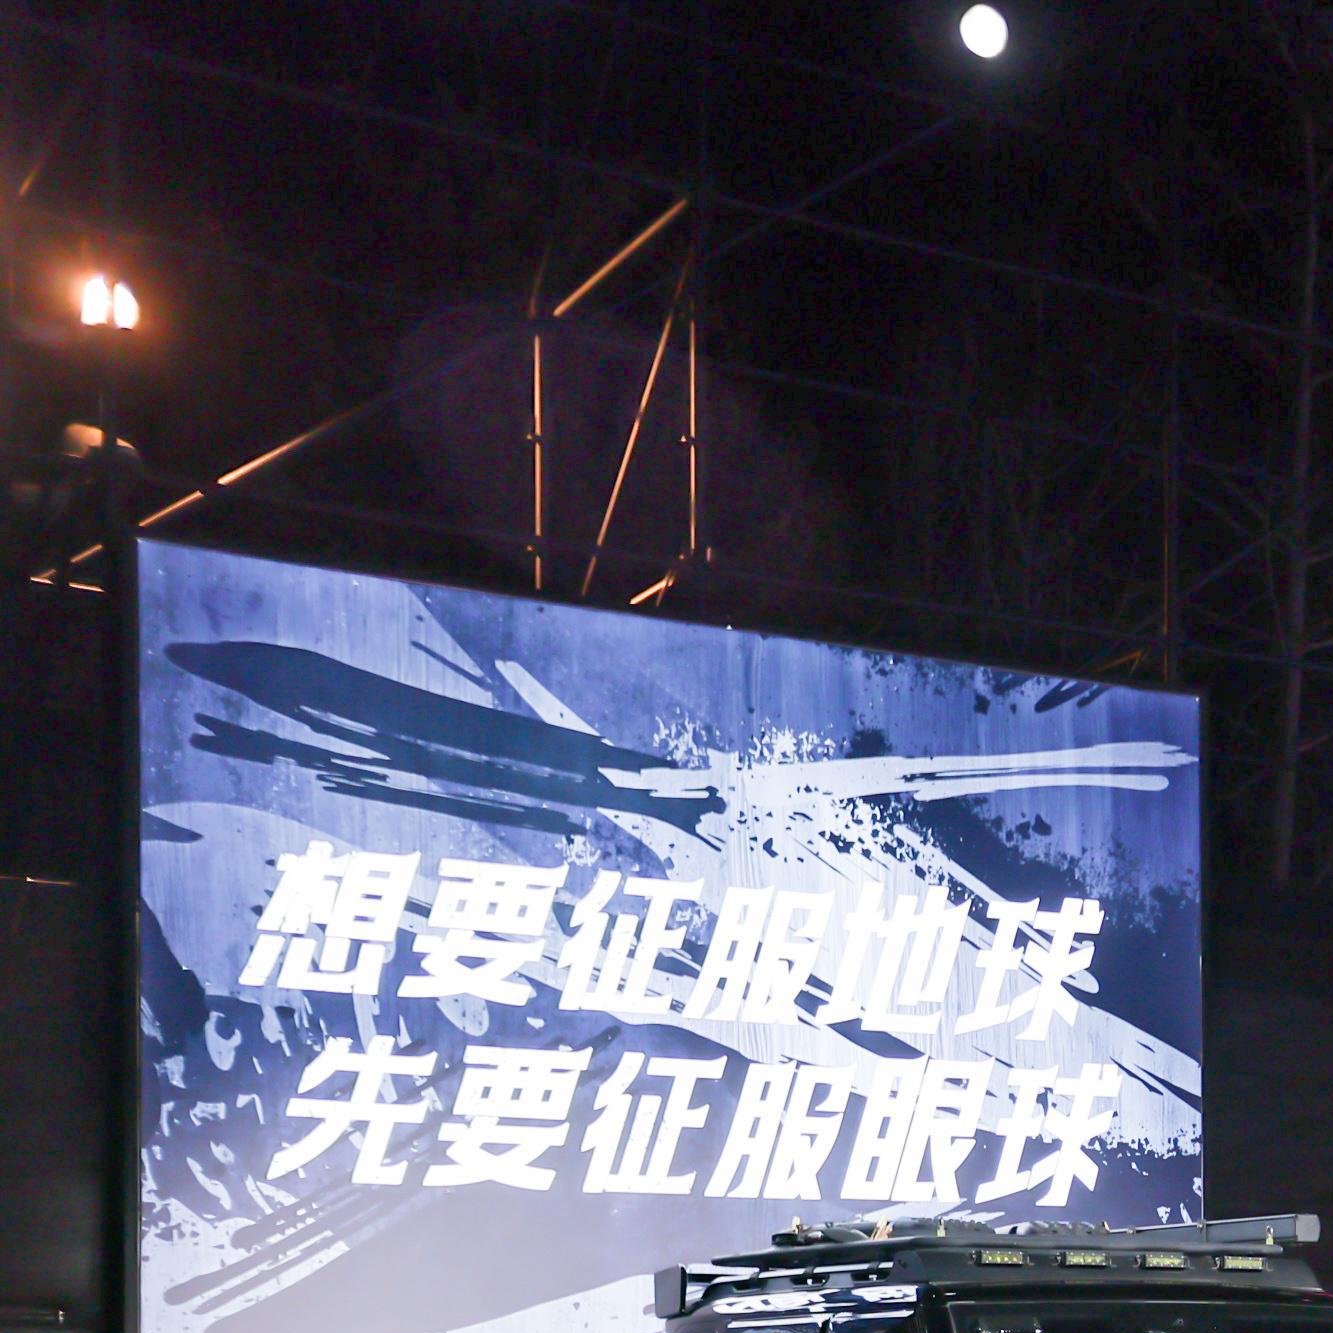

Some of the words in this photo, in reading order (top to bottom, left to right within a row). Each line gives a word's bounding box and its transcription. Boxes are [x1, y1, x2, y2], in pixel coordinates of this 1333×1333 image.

[238, 840, 1105, 1041] 想要征服地球
[266, 1035, 1122, 1208] 先要征服眼球
